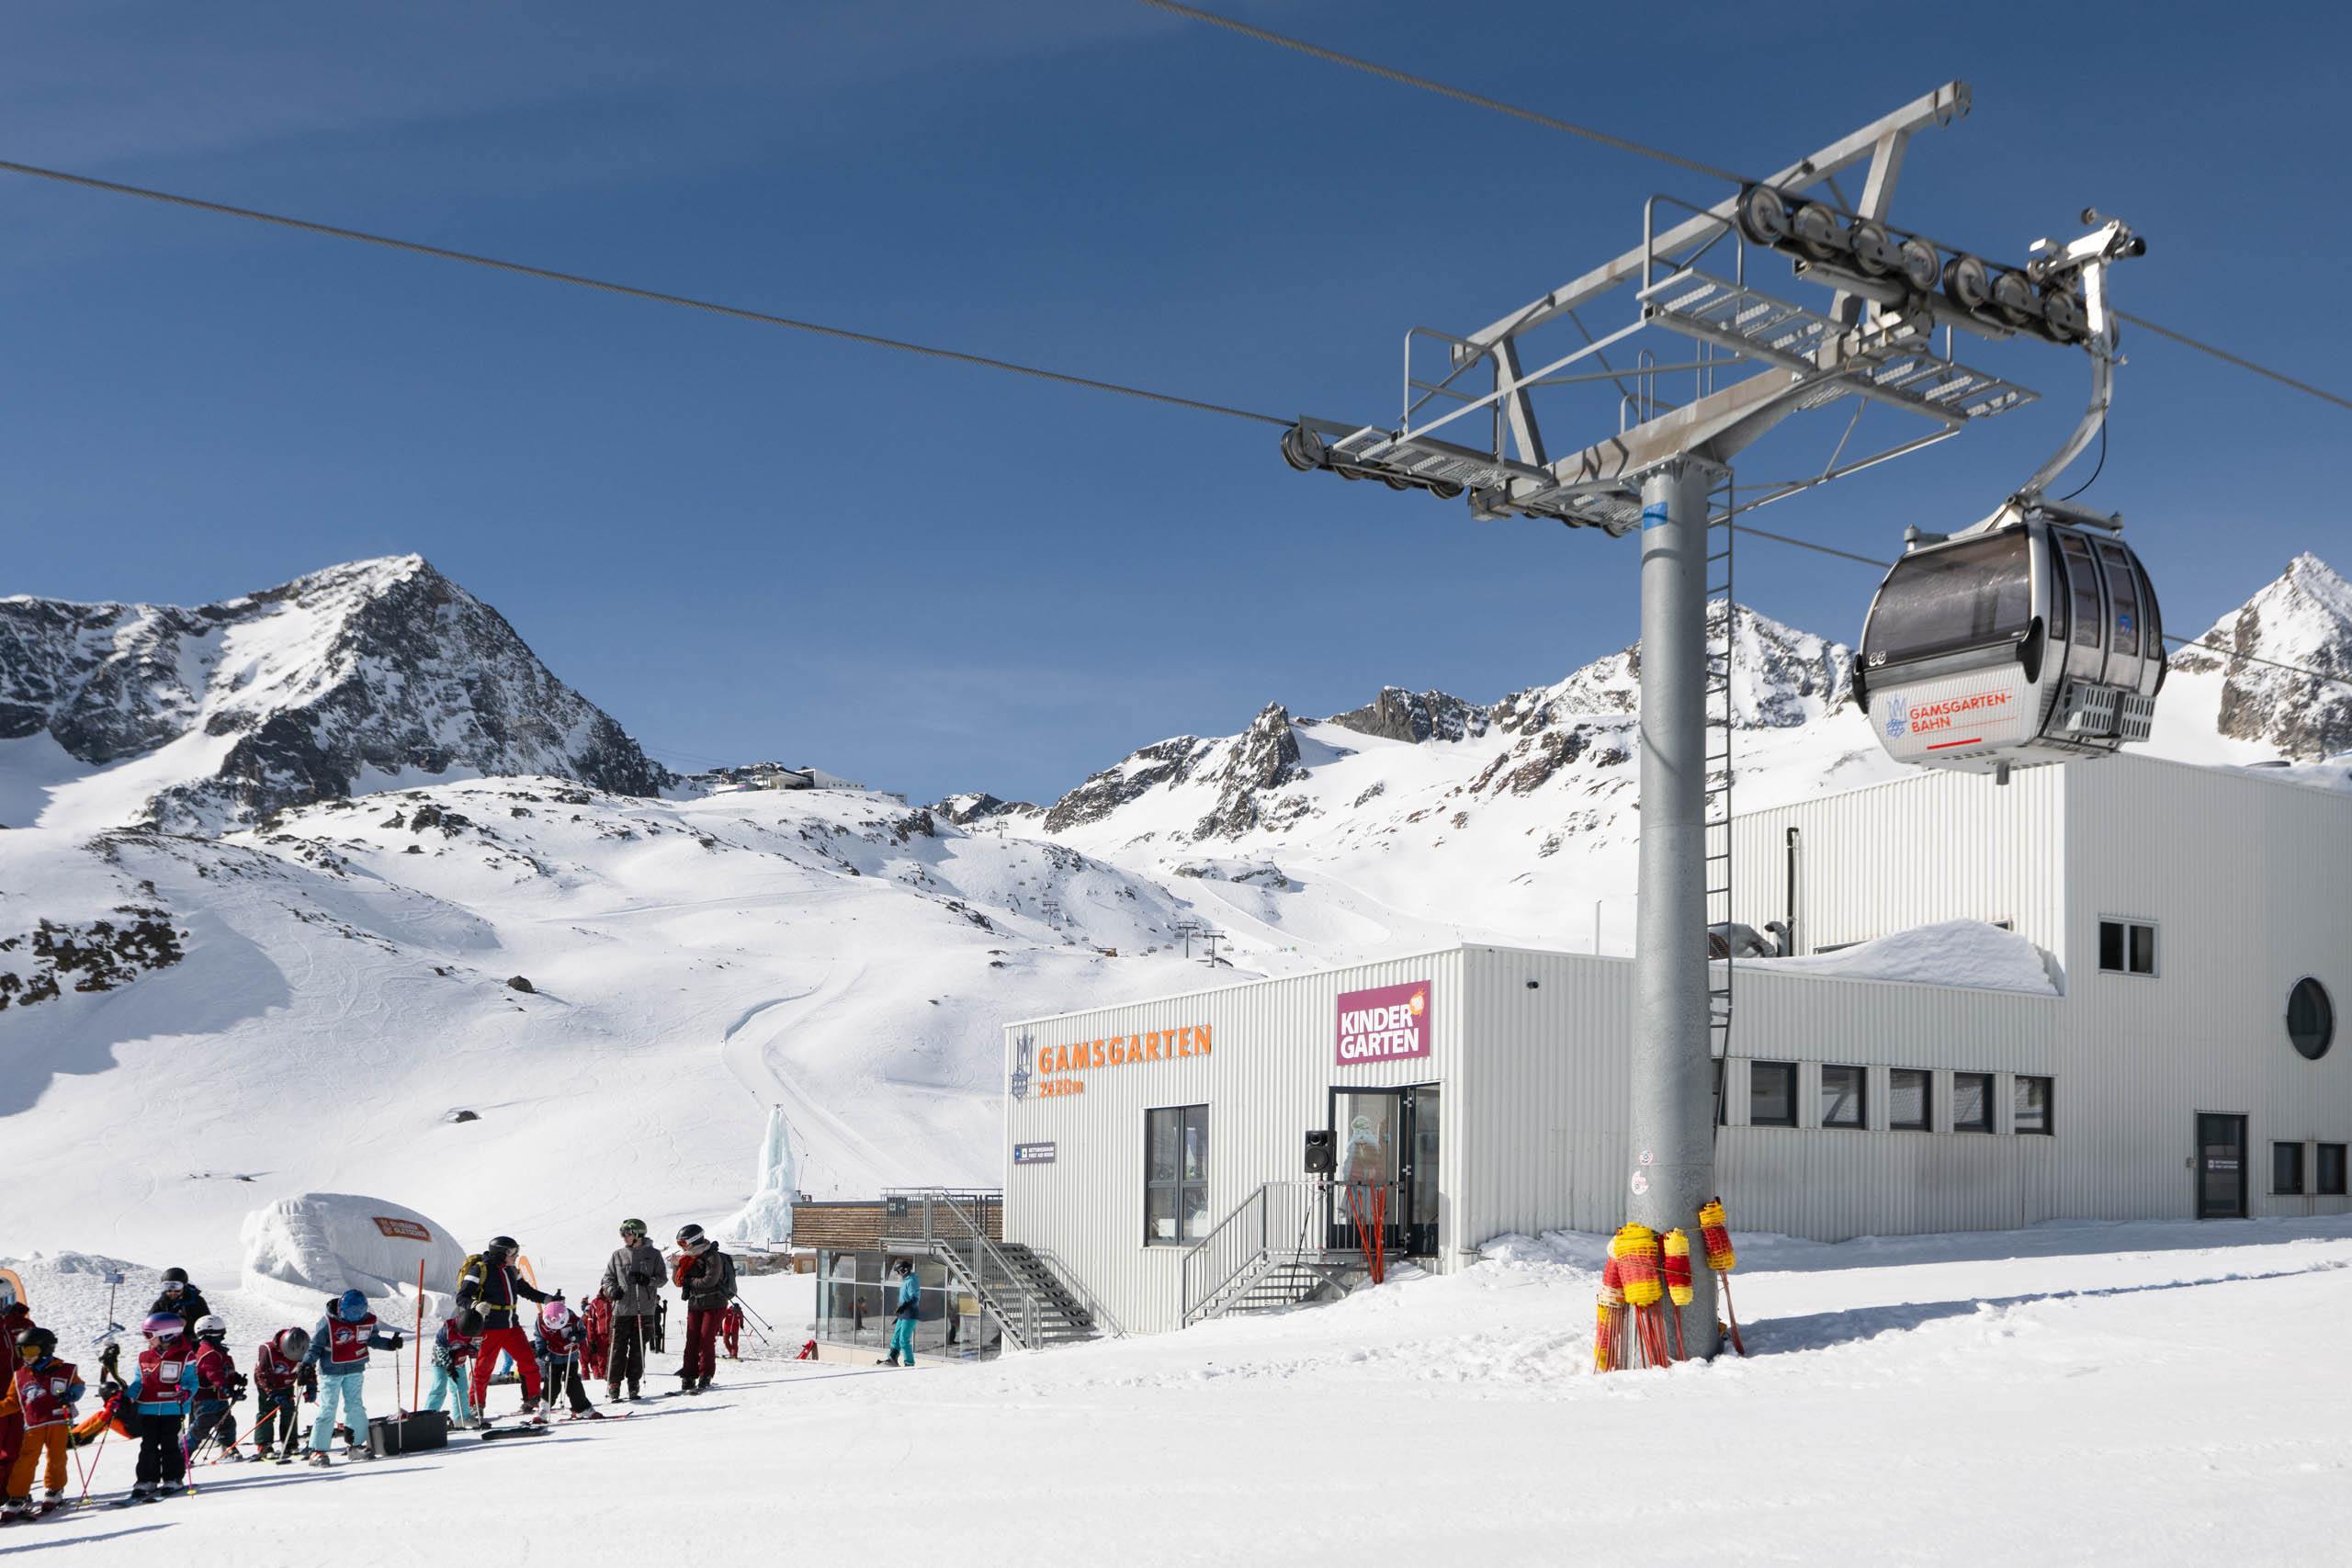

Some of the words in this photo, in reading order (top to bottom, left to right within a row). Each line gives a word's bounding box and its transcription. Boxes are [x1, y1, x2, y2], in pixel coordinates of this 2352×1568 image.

[1910, 693, 2013, 719] GAMSGARTEN-
[1911, 716, 1951, 733] BAHN
[1341, 1004, 1413, 1035] KINDER
[1038, 1023, 1212, 1075] GAMSGARTEN
[1340, 1028, 1419, 1059] GARTEN
[1039, 1078, 1083, 1098] 2620m
